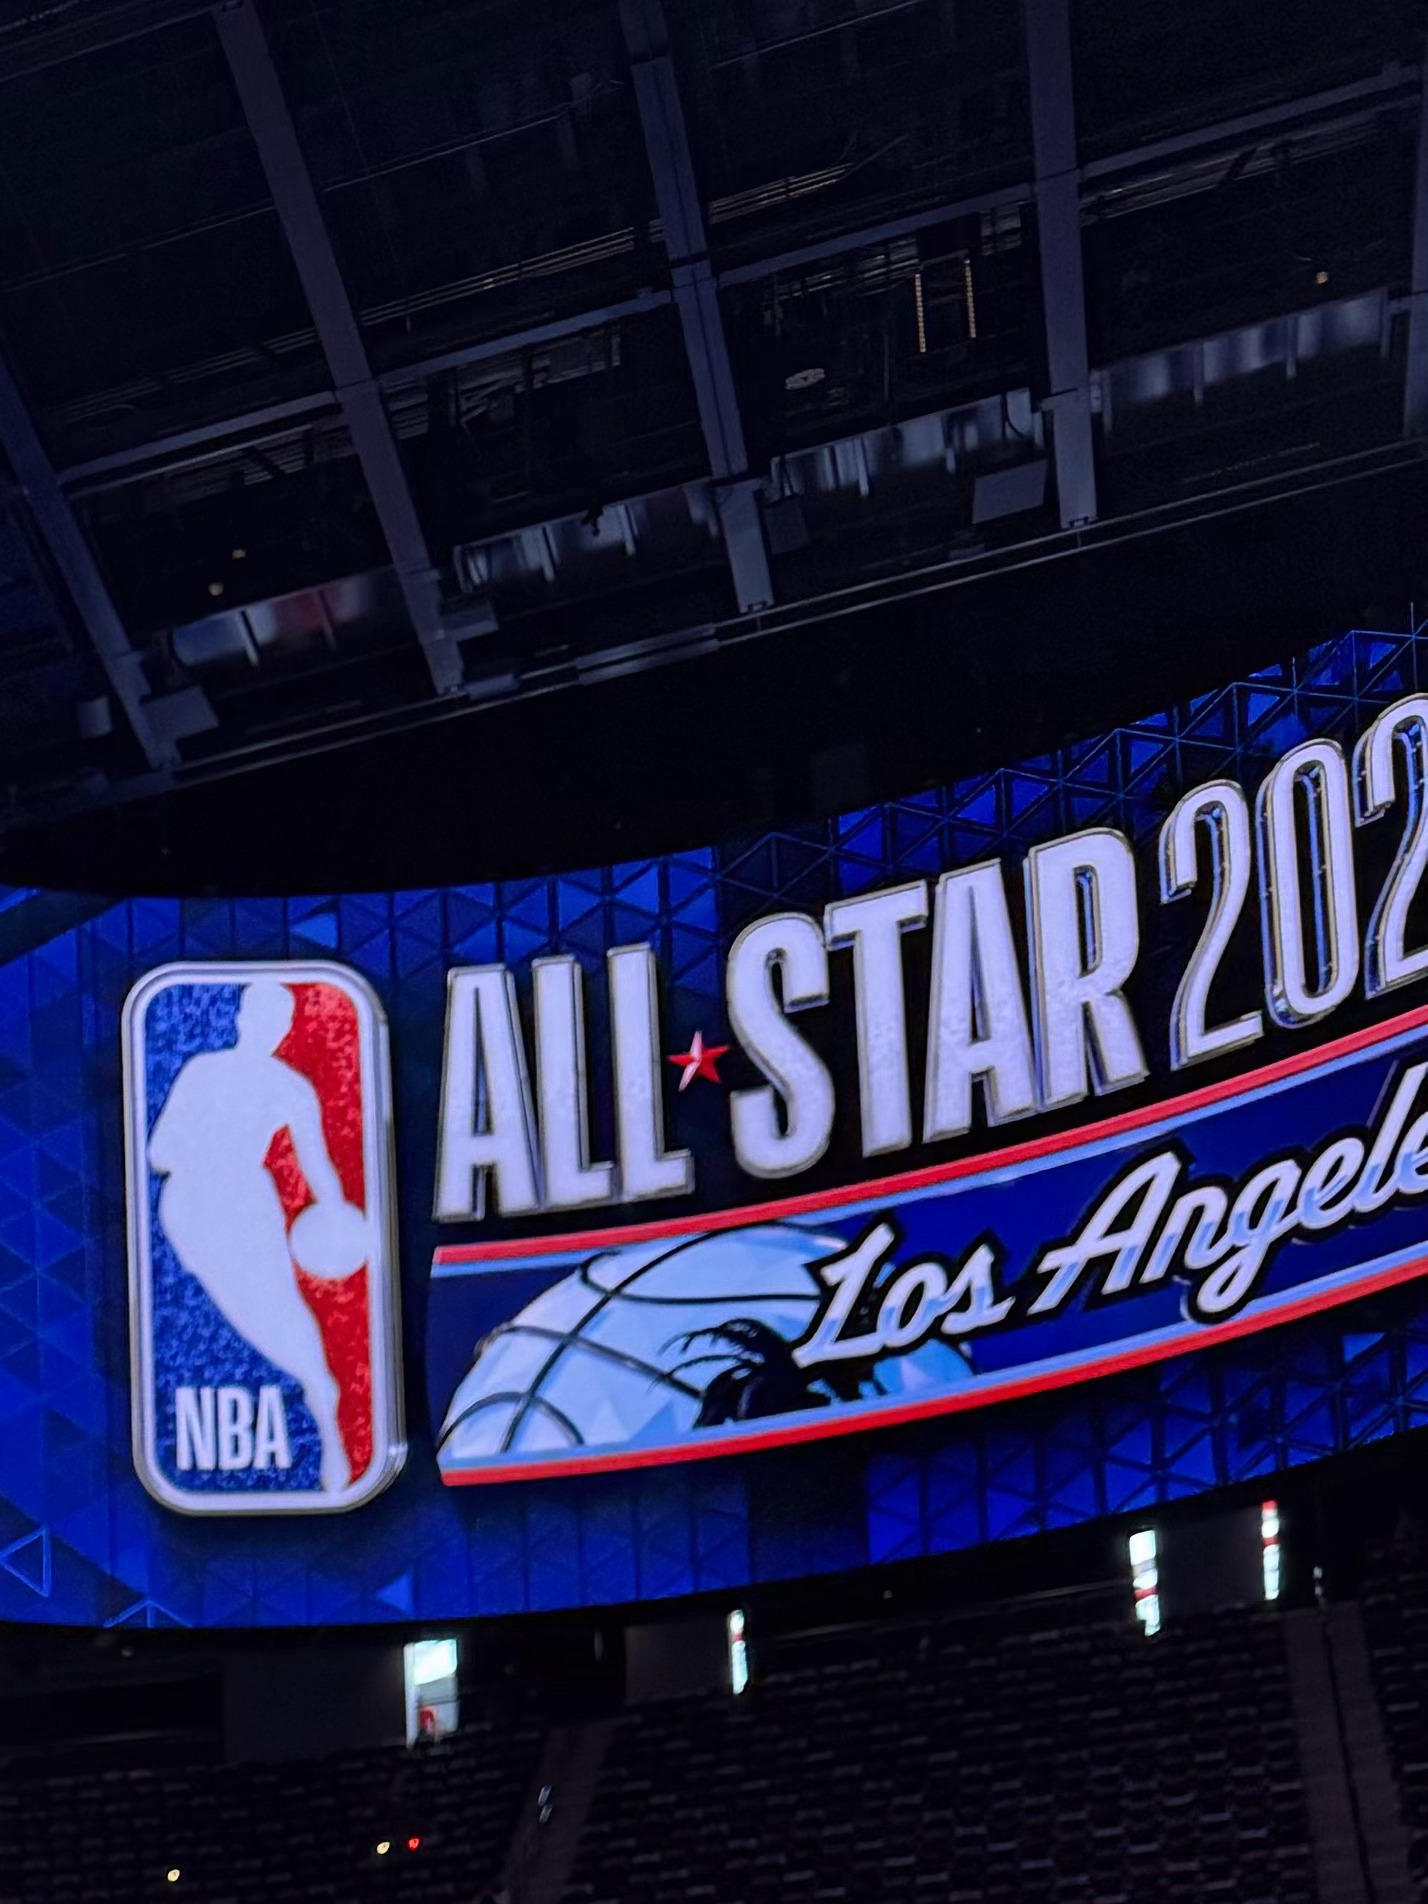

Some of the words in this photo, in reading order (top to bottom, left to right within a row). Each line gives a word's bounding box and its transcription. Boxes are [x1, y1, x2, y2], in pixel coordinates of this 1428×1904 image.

[432, 941, 695, 1222] ALL
[727, 826, 1150, 1180] STAR
[1159, 692, 1428, 1072] 202
[792, 1222, 1016, 1368] Los
[175, 1384, 293, 1472] NBA
